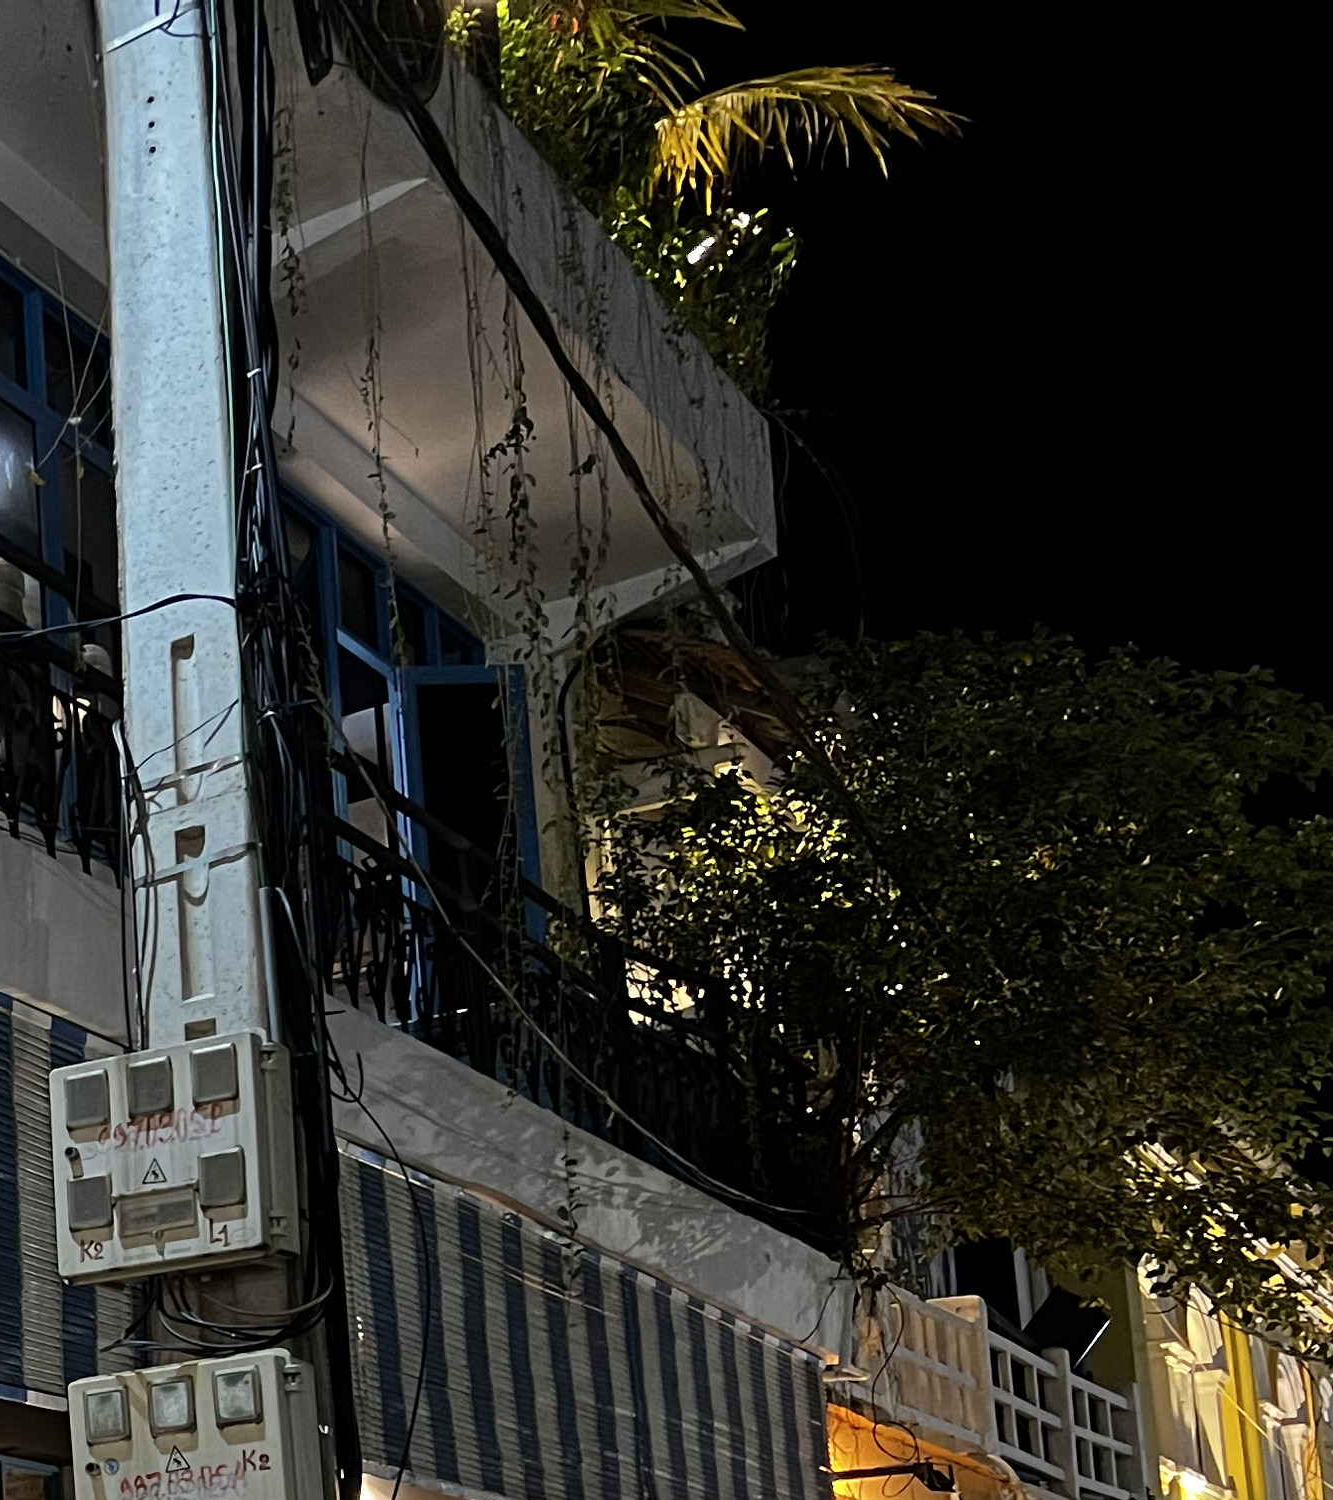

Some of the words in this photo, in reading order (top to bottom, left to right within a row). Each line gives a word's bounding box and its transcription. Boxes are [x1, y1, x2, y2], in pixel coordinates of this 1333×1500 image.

[209, 1218, 231, 1248] L1
[80, 1239, 104, 1263] K2
[242, 1449, 271, 1472] K2
